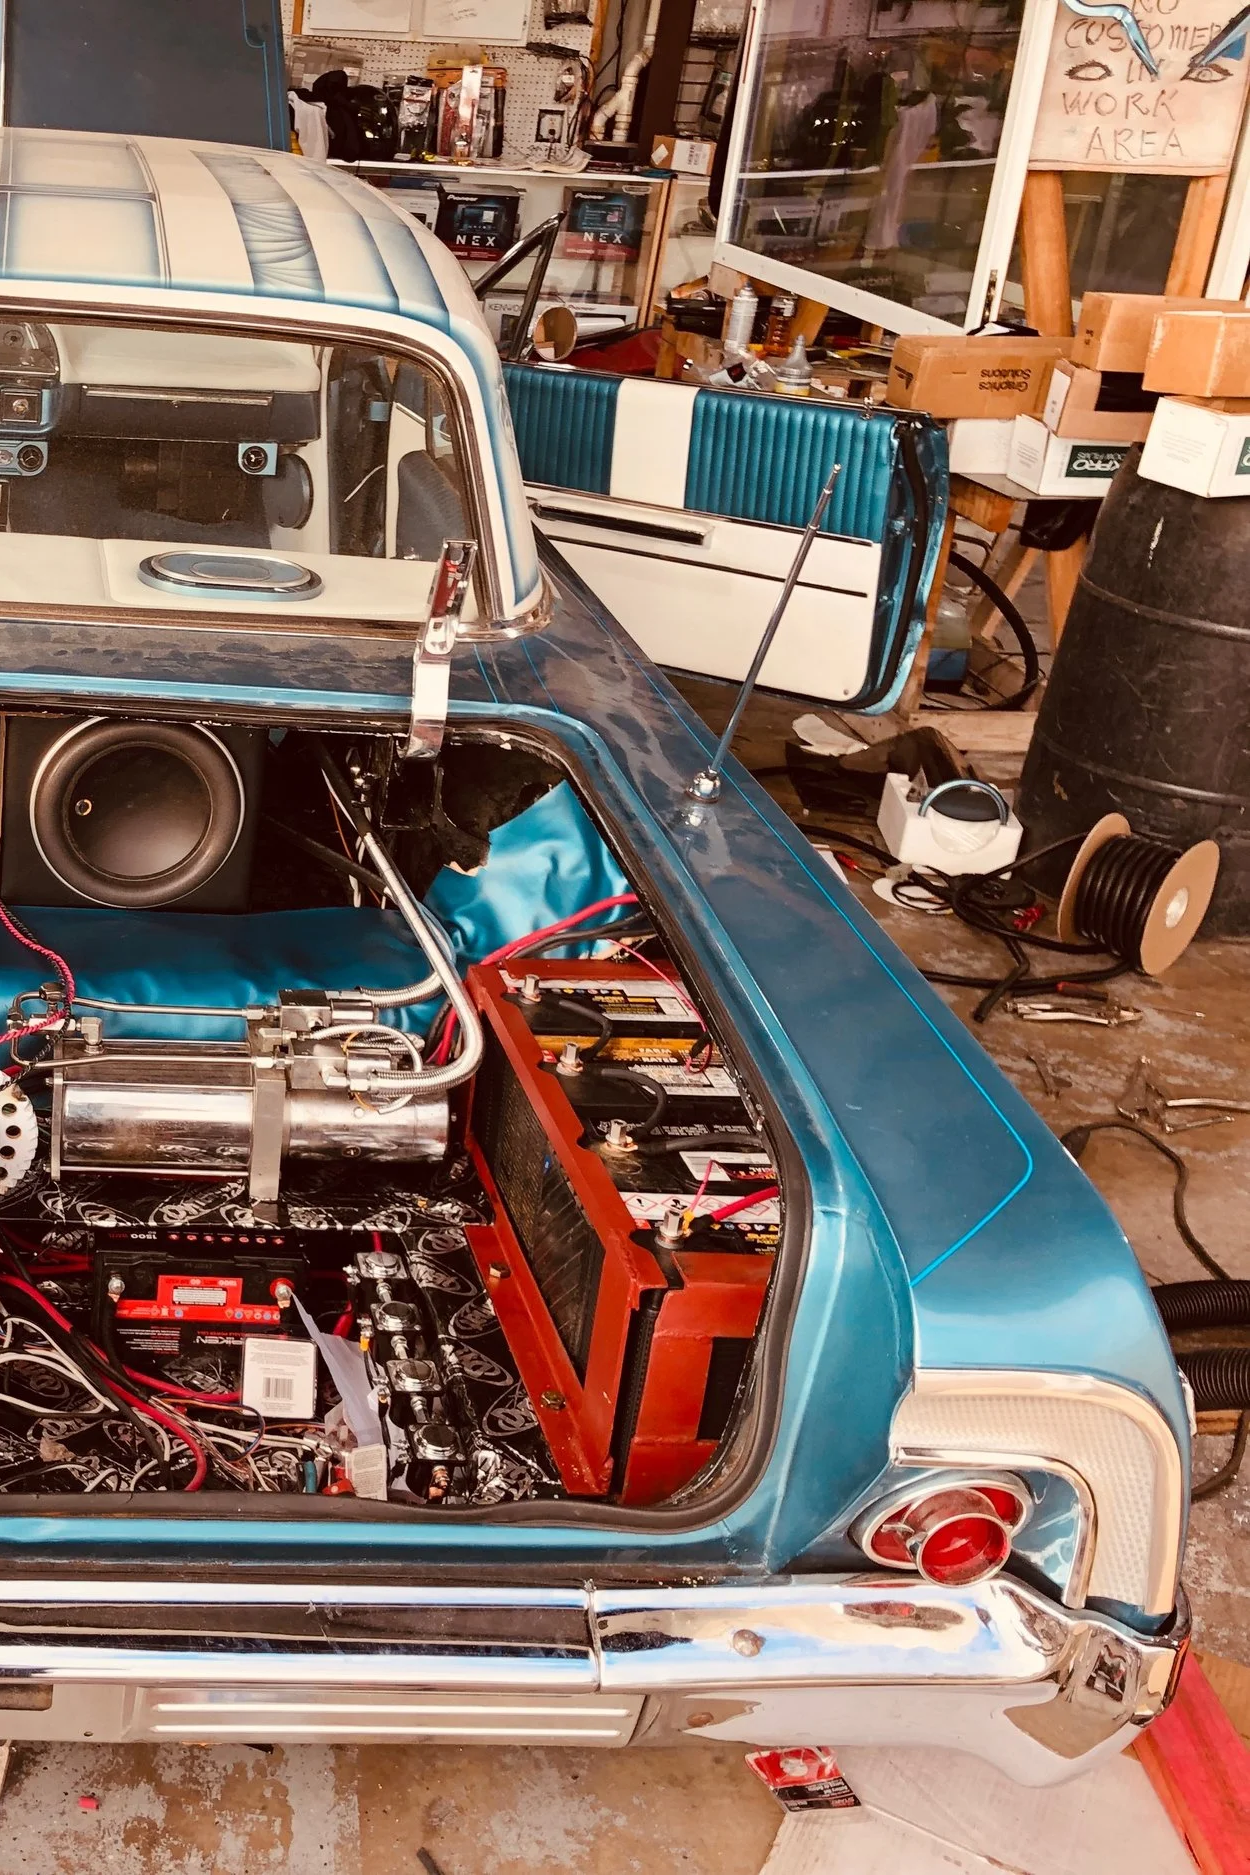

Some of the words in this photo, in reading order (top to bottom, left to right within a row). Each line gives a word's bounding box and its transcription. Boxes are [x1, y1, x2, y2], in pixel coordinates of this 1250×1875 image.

[1062, 89, 1178, 121] WORK
[1086, 126, 1185, 162] AREA
[447, 194, 478, 203] Pioneer
[574, 192, 605, 201] Pioneer
[456, 234, 496, 247] NEX
[584, 231, 622, 244] NEX
[980, 368, 1032, 379] Solutions
[978, 381, 1028, 393] Graphics
